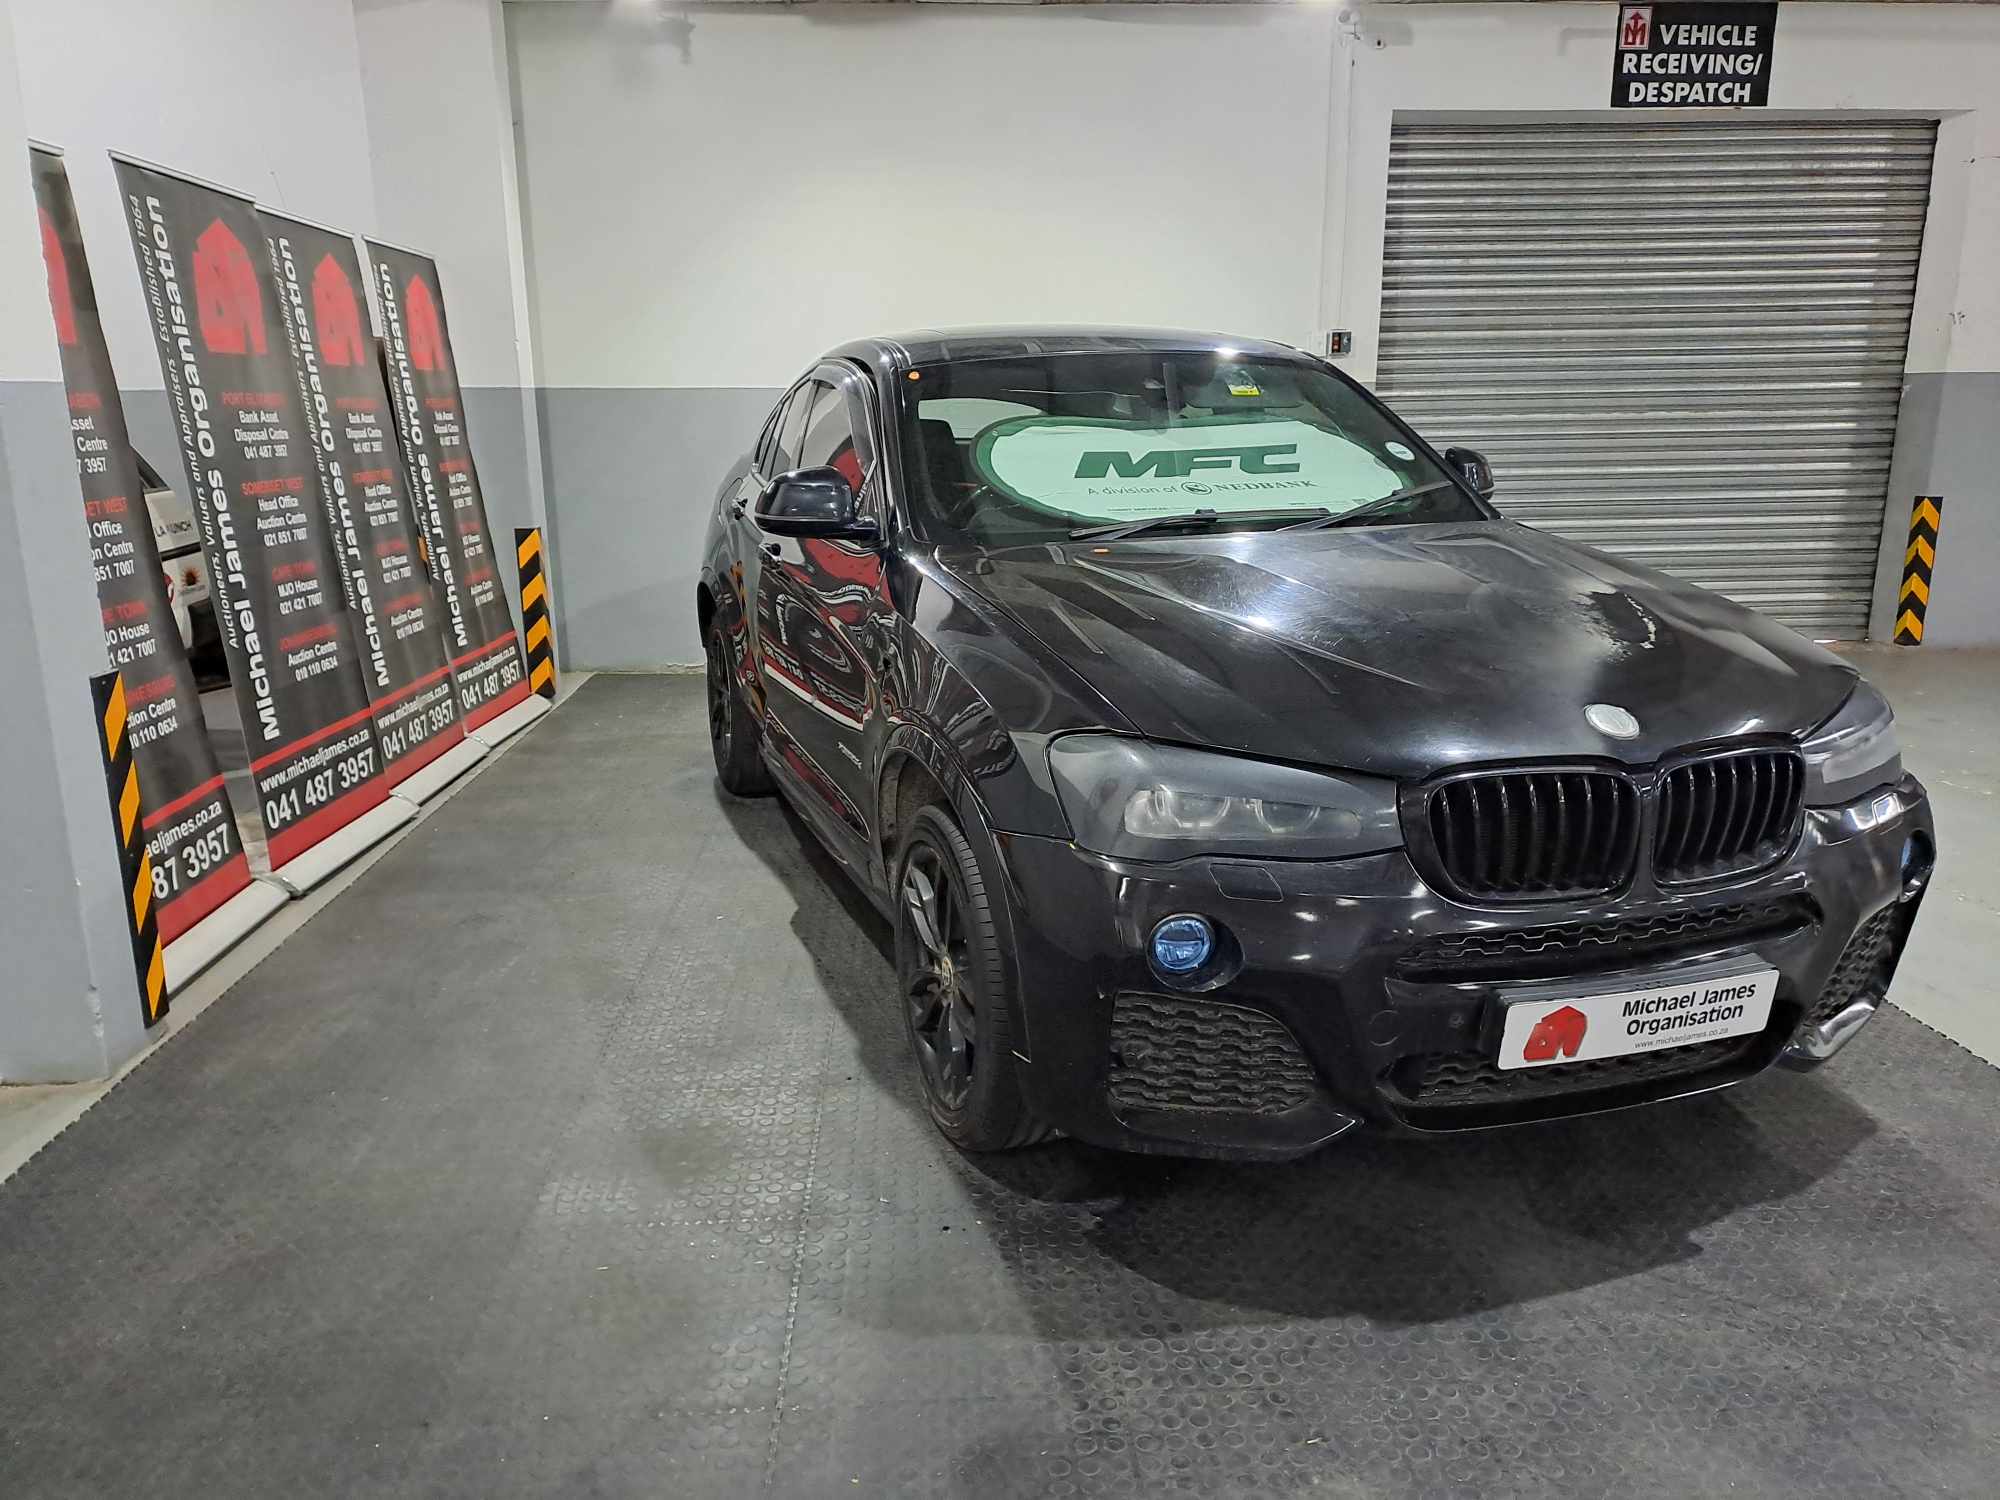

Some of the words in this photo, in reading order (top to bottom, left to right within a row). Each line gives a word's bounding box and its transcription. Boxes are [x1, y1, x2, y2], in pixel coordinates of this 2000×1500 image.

[1660, 24, 1757, 46] VEHICLE
[1622, 53, 1763, 75] RECEIVING/
[1628, 82, 1751, 103] DESPATCH
[129, 194, 147, 238] 1964
[139, 243, 169, 342] Established
[146, 196, 215, 458] Organisation
[279, 238, 335, 452] Organisation
[380, 263, 423, 445] Organisation
[71, 416, 94, 431] sset
[168, 358, 194, 446] Appraisers
[77, 436, 108, 452] Centre
[84, 457, 107, 473] 3957
[186, 450, 201, 482] and
[312, 445, 325, 471] and
[1074, 443, 1300, 478] MFC
[418, 453, 444, 539] James
[1102, 486, 1157, 495] division
[1214, 481, 1319, 491] NEDBANK
[92, 521, 123, 538] Office
[196, 487, 215, 545] Valuers
[208, 470, 247, 589] James
[330, 461, 361, 561] James
[104, 541, 134, 558] Centre
[436, 546, 468, 647] Michael
[119, 623, 150, 642] House
[352, 570, 390, 687] Michael
[117, 647, 135, 664] 421
[234, 600, 280, 741] Michael
[461, 682, 482, 709] 041
[483, 672, 499, 697] 487
[502, 659, 521, 687] 3957
[148, 697, 176, 718] Centre
[382, 728, 407, 760] 041
[408, 715, 428, 744] 487
[429, 699, 454, 732] 3957
[260, 728, 369, 793] www.michaeljames.co.za
[266, 788, 301, 829] 041
[305, 769, 334, 806] 487
[338, 747, 375, 788] 3957
[182, 823, 230, 879] 3957
[1622, 991, 1696, 1017] Michael
[1699, 984, 1756, 1006] James
[1626, 1005, 1744, 1036] Organisation
